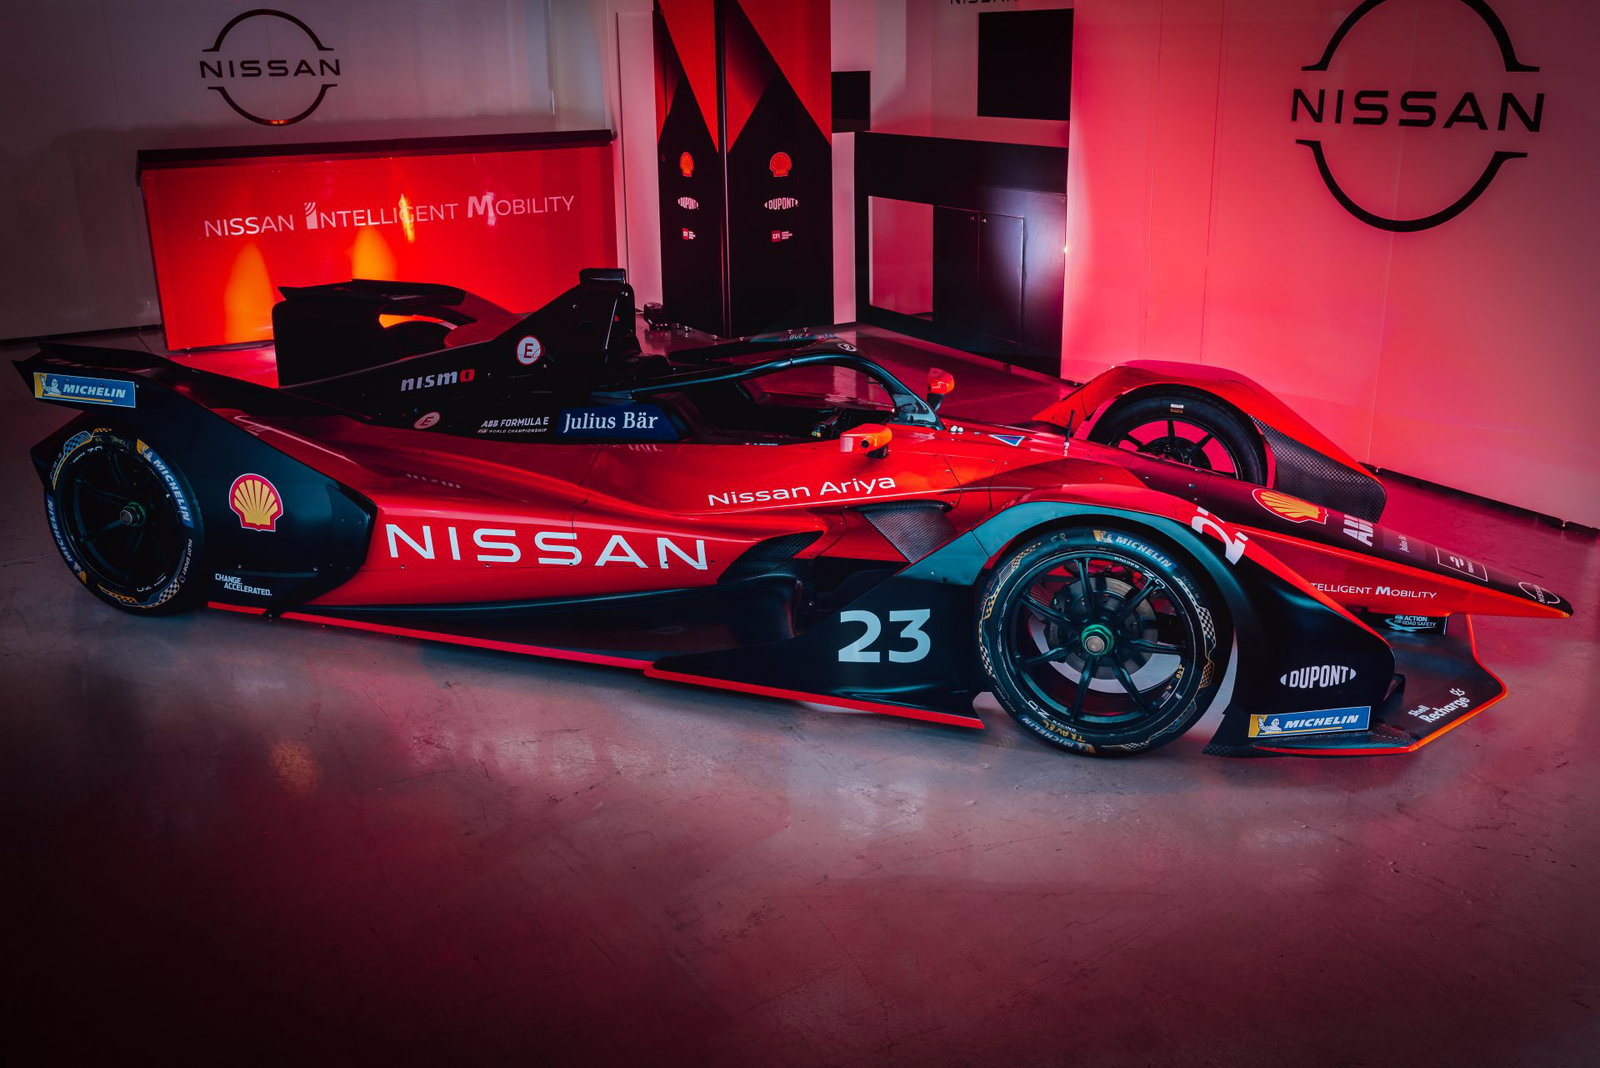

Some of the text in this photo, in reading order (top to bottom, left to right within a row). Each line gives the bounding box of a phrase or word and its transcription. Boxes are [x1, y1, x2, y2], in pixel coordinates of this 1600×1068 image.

[200, 59, 341, 78] NISSAN
[1291, 88, 1545, 132] NISSAN
[204, 195, 575, 237] NISSAN INTELLIGENT MOBILITY
[767, 197, 795, 211] DUPONT
[63, 384, 126, 398] MICHELIN
[400, 369, 476, 392] nismo
[481, 416, 550, 428] ABB FORMULA E
[563, 411, 658, 433] Julius Bär
[153, 459, 190, 521] MICHELIN
[708, 477, 896, 506] Nissan Ariya
[385, 523, 709, 571] NISSAN
[1115, 535, 1173, 568] MICHELIN
[224, 582, 273, 596] ACCELERATED.
[1375, 586, 1437, 599] MOBILITY
[838, 608, 931, 664] 23
[1288, 664, 1349, 689] DUPONT
[1408, 704, 1430, 717] Shell
[1418, 697, 1470, 722] Recharge
[1021, 717, 1075, 748] MICHELIN
[1284, 714, 1360, 730] MICHELIN
